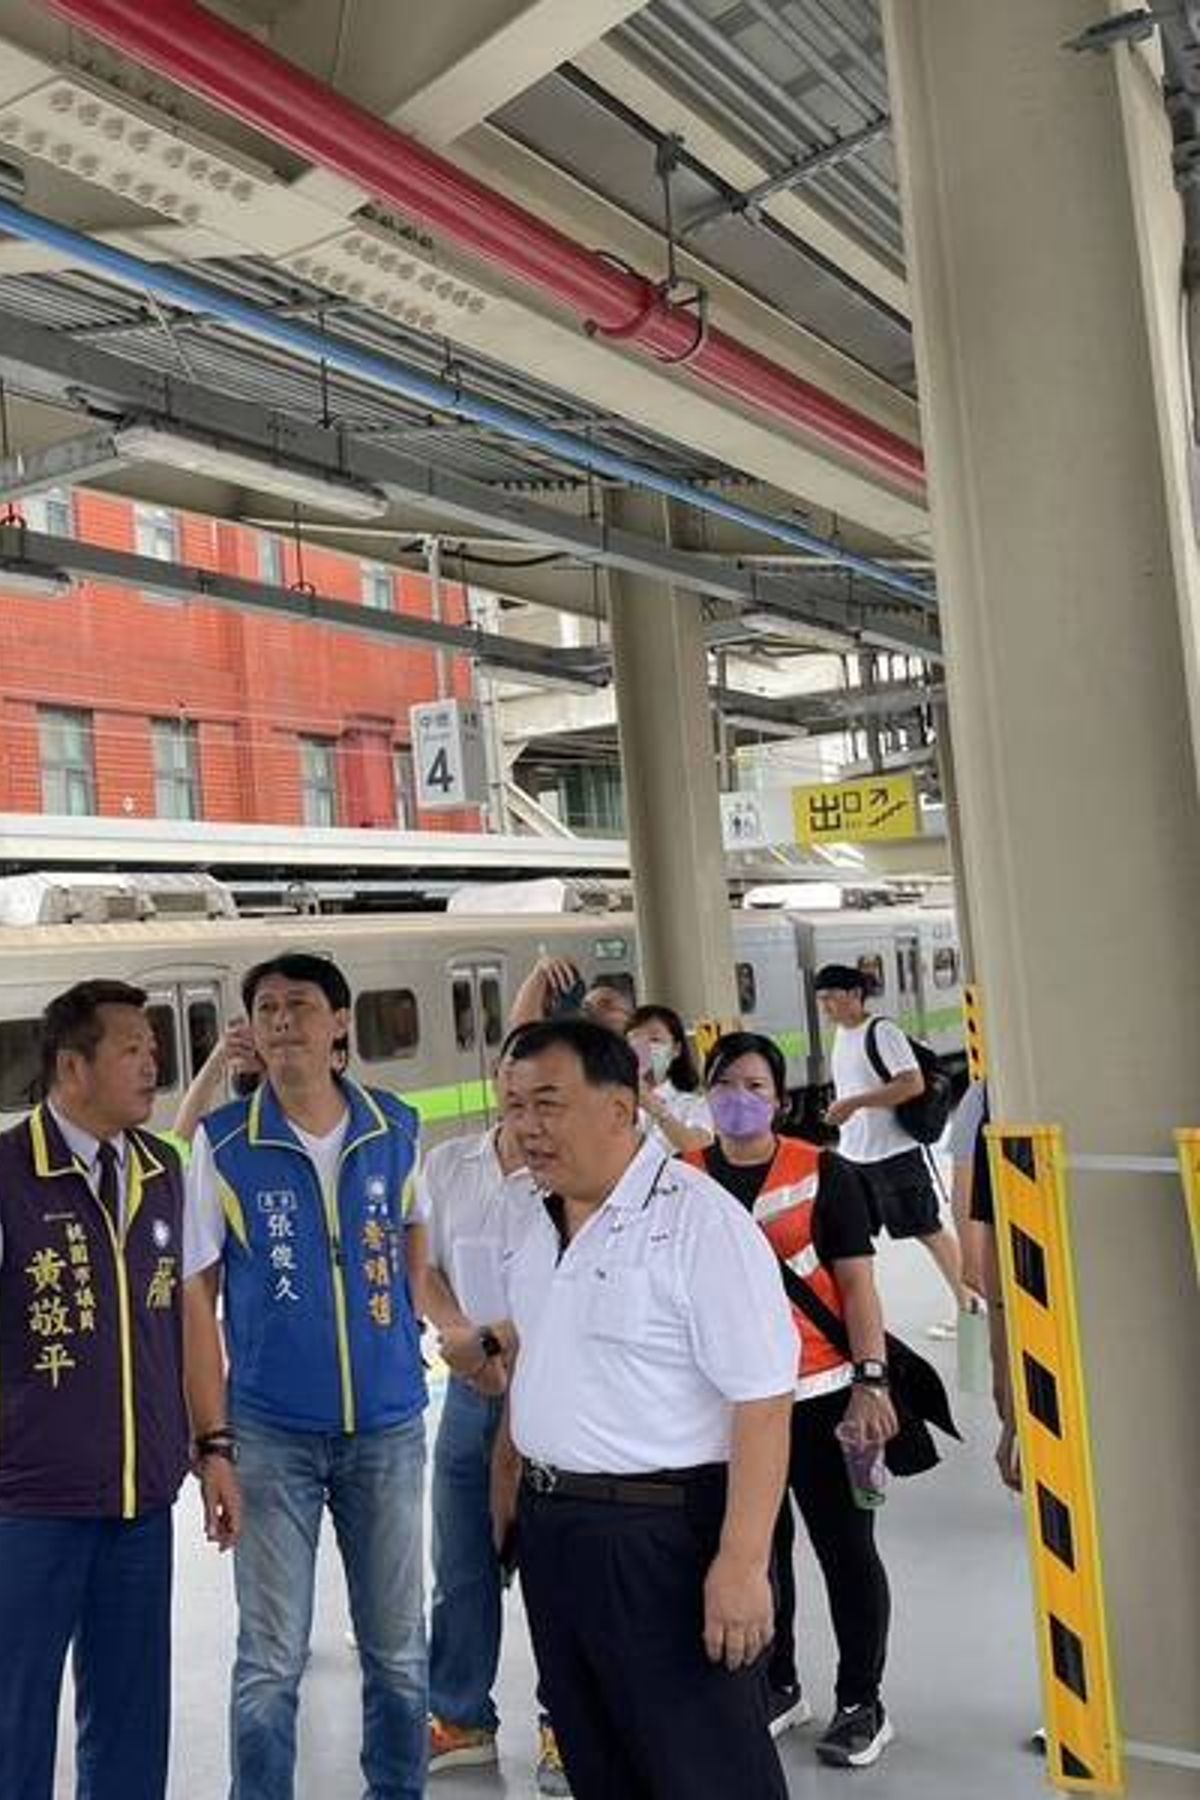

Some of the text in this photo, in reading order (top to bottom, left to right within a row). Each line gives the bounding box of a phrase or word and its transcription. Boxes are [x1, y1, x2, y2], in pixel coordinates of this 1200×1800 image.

[426, 746, 454, 793] 4
[809, 790, 863, 832] 出口
[25, 1246, 76, 1390] 黃敬平
